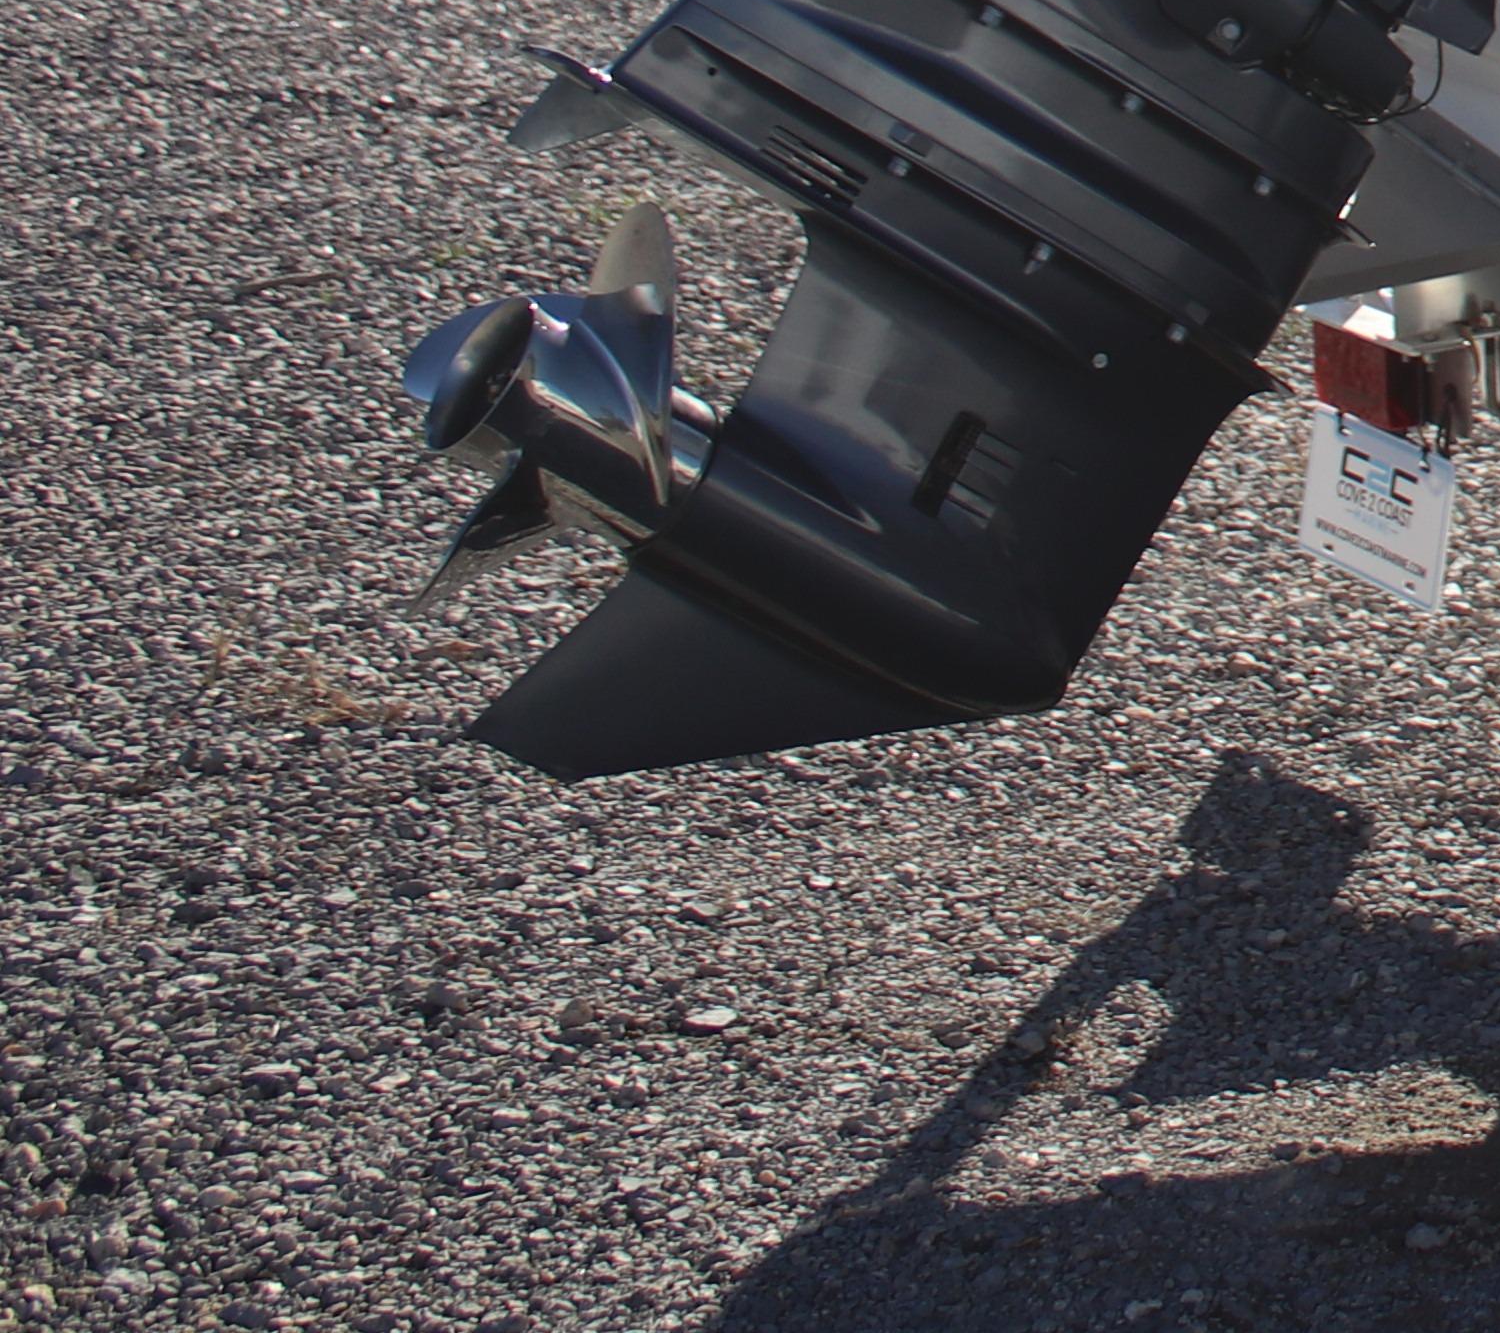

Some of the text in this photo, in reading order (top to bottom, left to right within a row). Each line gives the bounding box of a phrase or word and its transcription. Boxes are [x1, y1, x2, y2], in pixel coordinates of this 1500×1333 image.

[1336, 480, 1368, 508] COVE
[1368, 492, 1377, 514] 2
[1376, 498, 1415, 529] COAST
